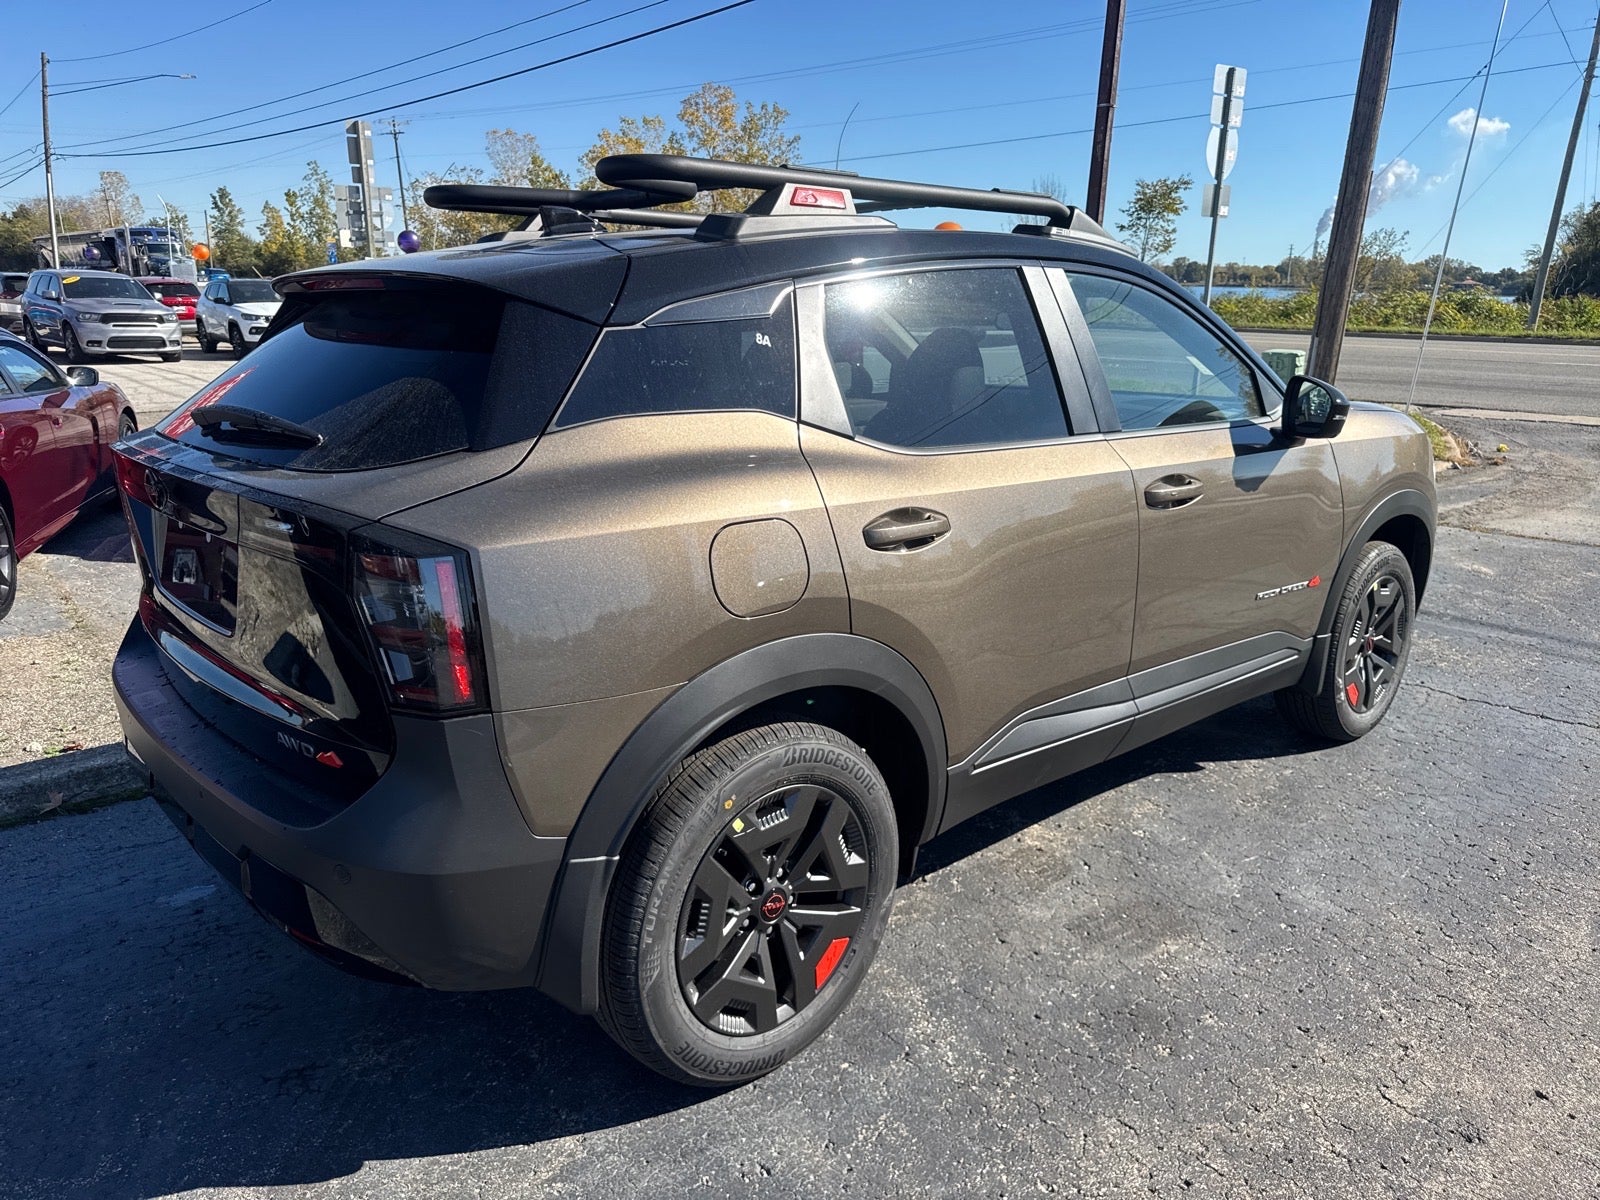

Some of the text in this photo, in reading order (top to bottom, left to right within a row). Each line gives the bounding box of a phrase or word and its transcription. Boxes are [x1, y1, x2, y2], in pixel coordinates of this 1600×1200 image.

[755, 332, 771, 348] 8A
[277, 731, 315, 758] AWD
[782, 747, 878, 796] BRIDGESTONE
[673, 1041, 786, 1077] BRIDGESTONE
